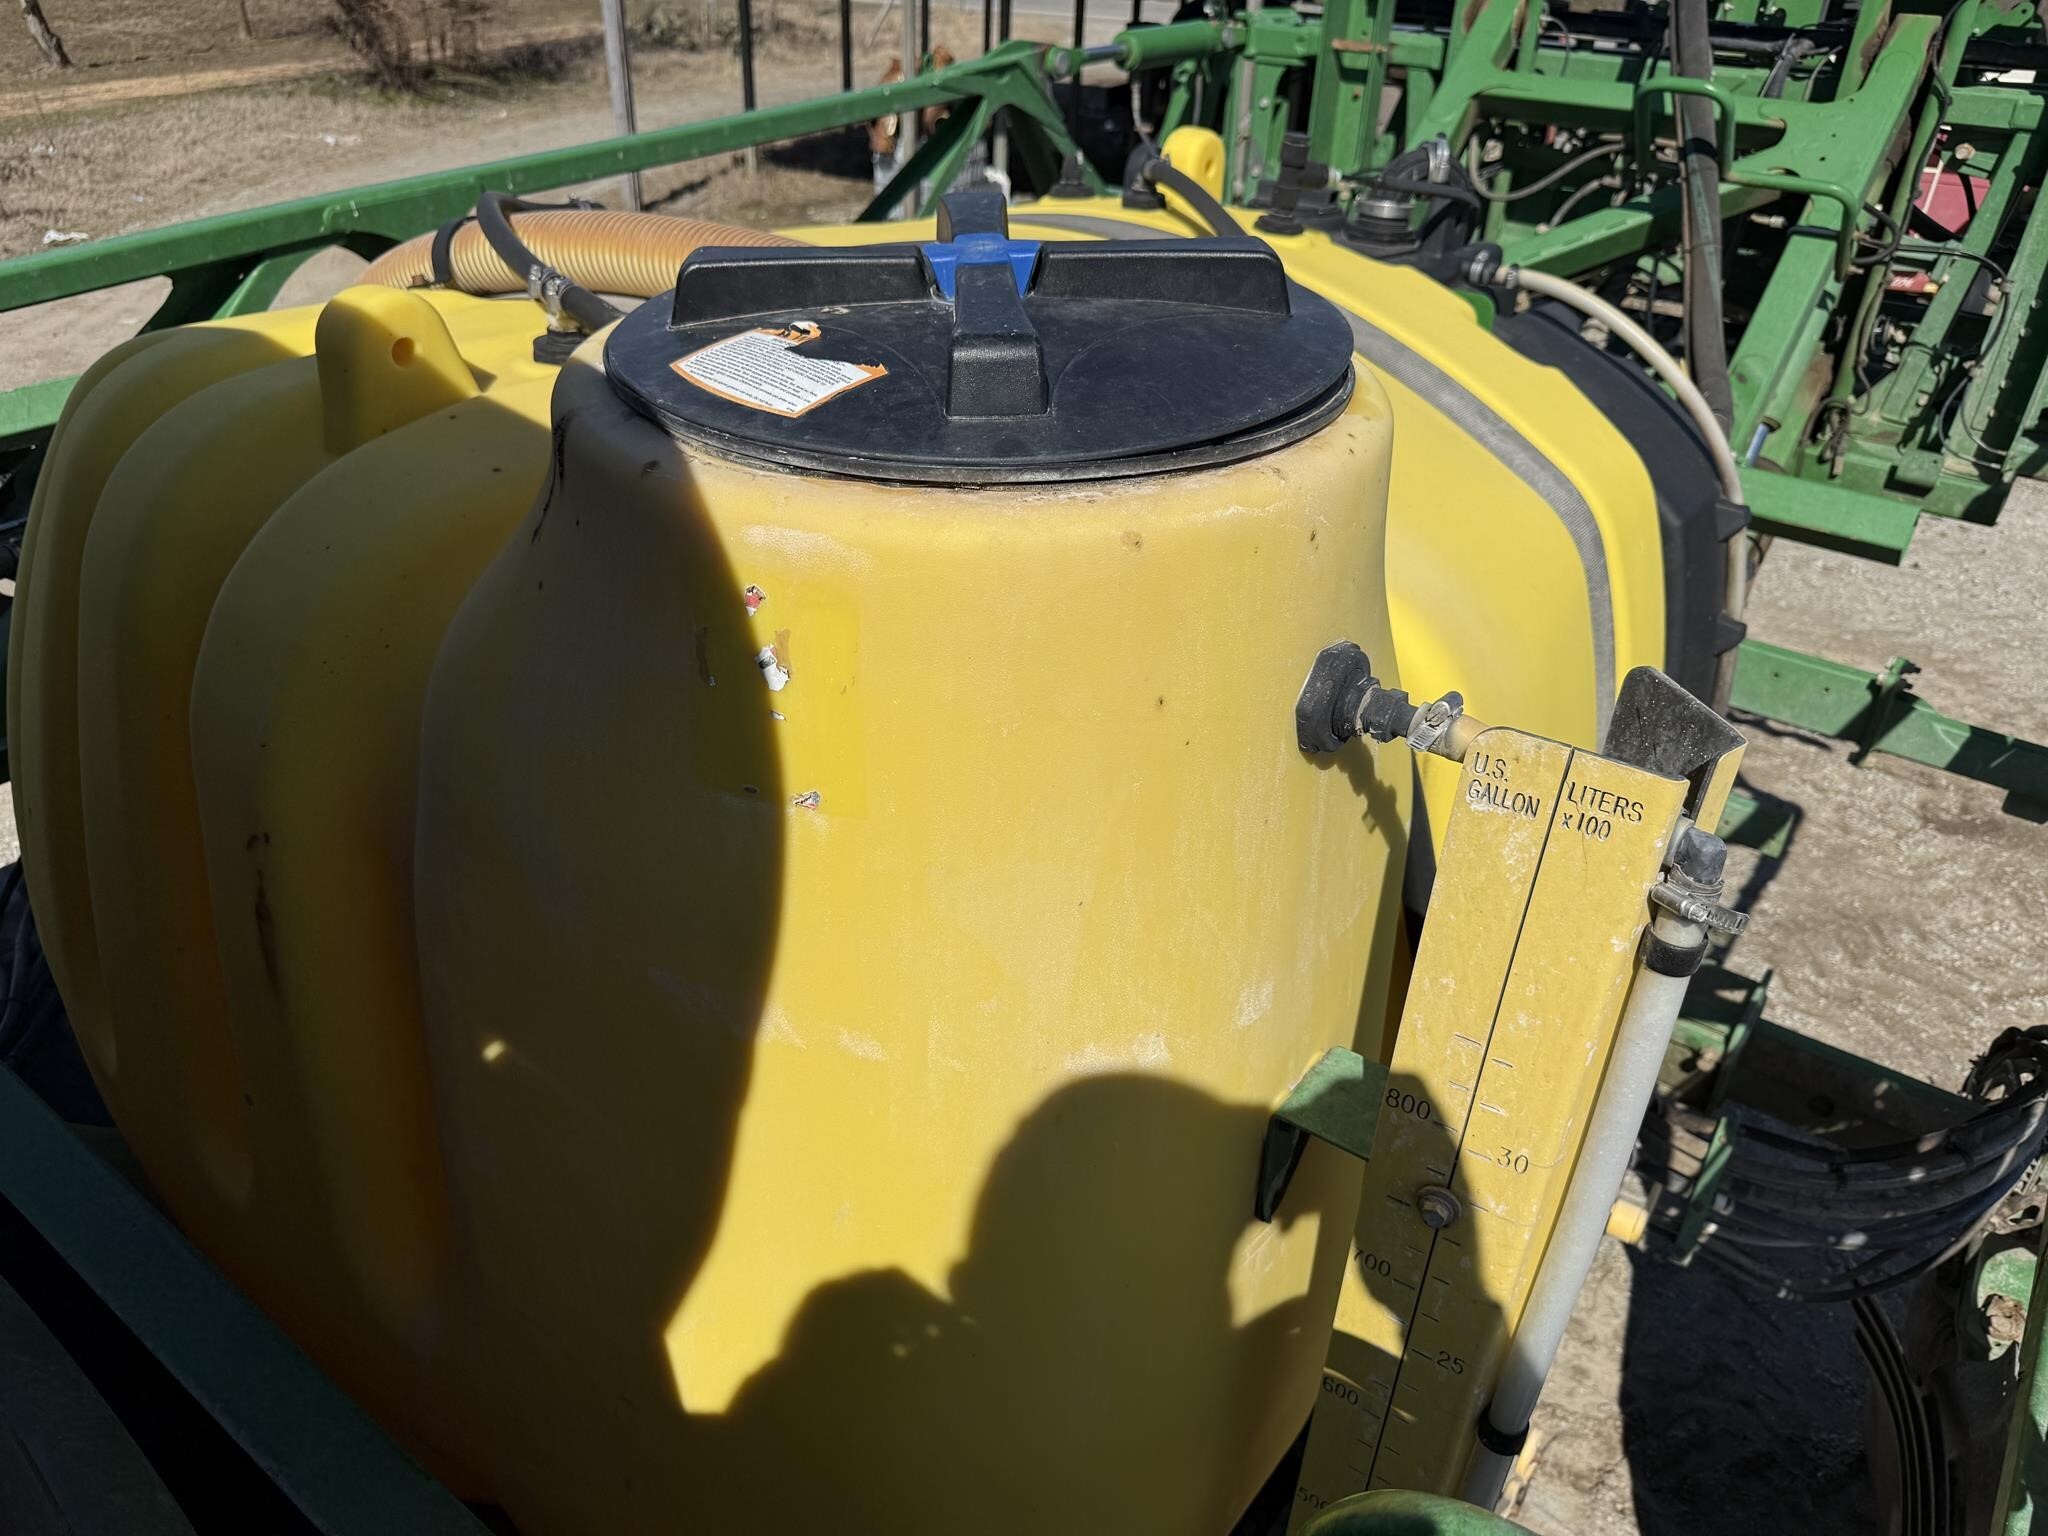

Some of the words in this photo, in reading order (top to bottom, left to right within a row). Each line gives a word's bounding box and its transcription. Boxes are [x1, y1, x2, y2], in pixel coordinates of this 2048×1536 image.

[1473, 752, 1508, 783] U.S.
[1468, 779, 1541, 819] GALLON
[1566, 781, 1645, 823] LITERS
[1385, 1088, 1431, 1120] 800
[1496, 1146, 1529, 1175] 30
[1354, 1247, 1391, 1277] 700
[1436, 1350, 1465, 1375] 25
[1322, 1375, 1359, 1406] 600
